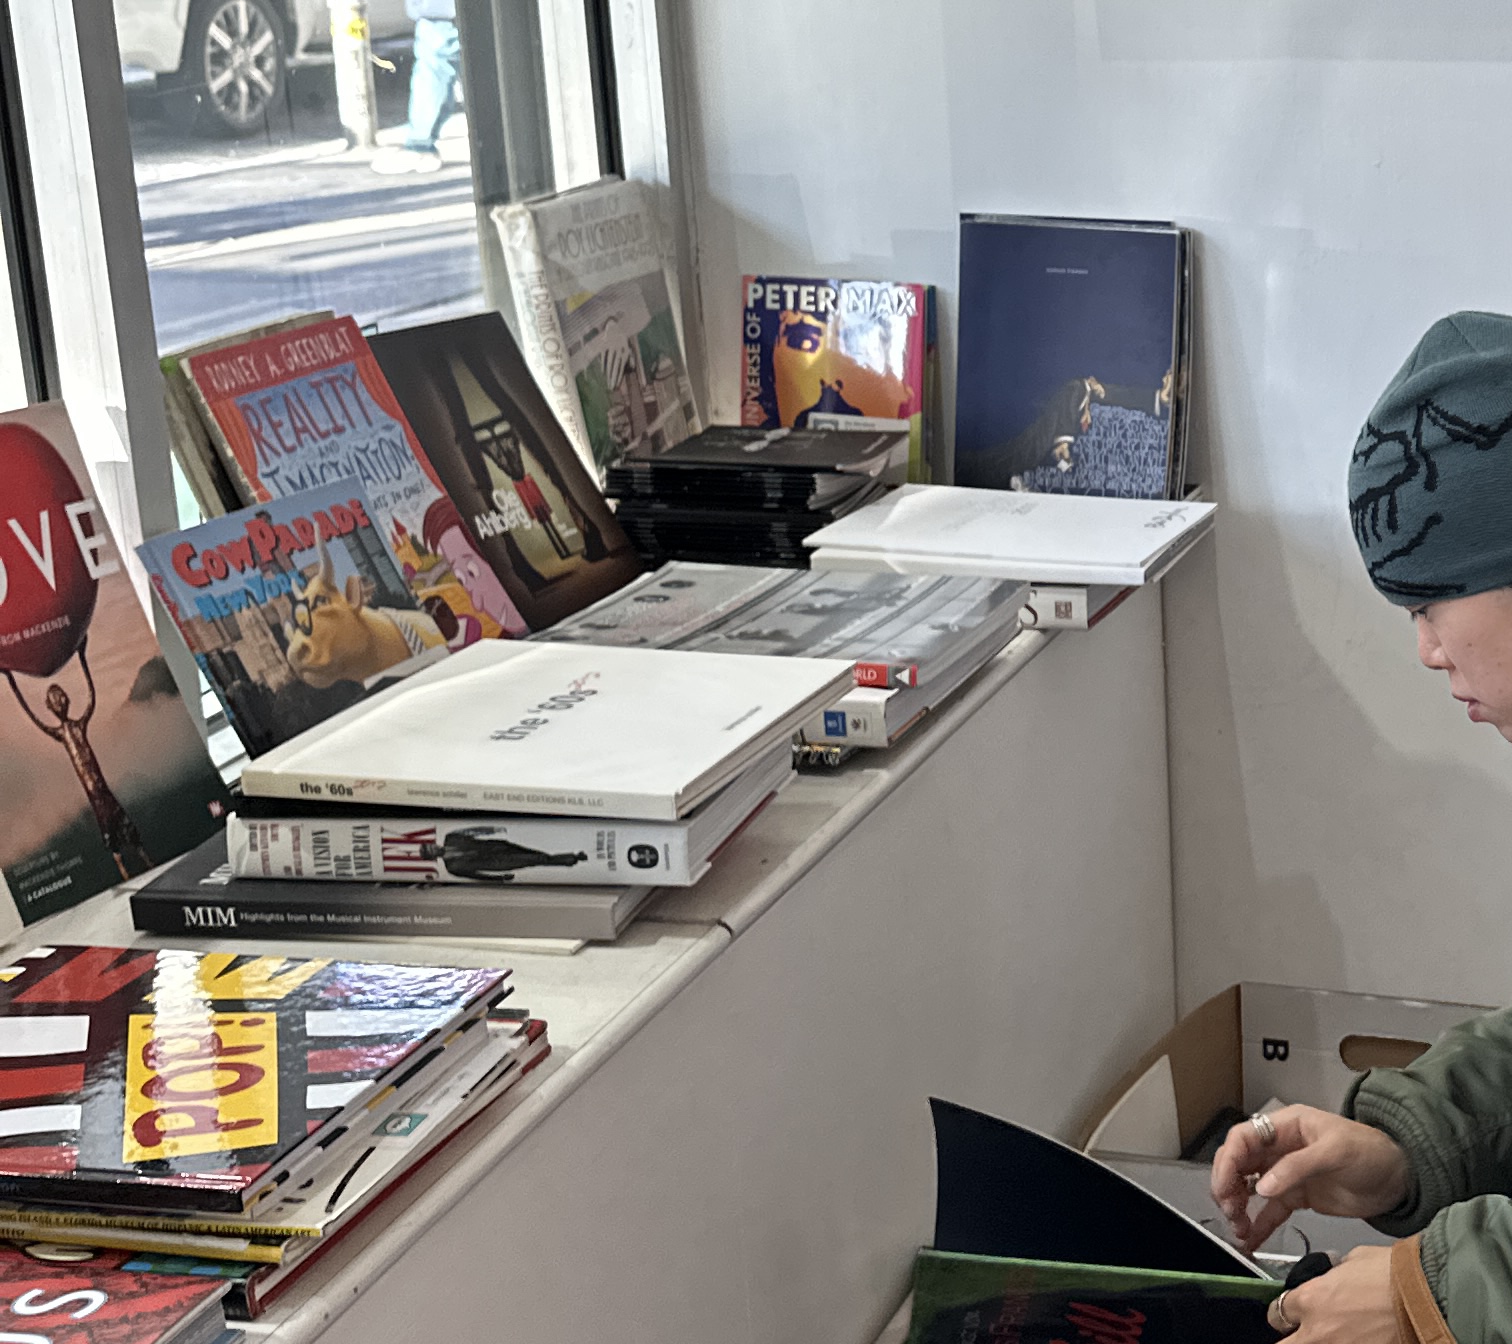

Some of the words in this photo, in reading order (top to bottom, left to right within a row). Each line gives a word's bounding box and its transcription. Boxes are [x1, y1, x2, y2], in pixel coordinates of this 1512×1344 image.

[747, 283, 836, 312] PETER
[846, 285, 916, 317] MAX
[746, 313, 762, 339] OF
[205, 356, 258, 394] RODNEY
[279, 326, 355, 373] GREENBLAT
[240, 370, 373, 467] REALITY
[317, 441, 341, 459] AND
[493, 488, 520, 511] Ole
[474, 508, 533, 540] Ahlberg
[196, 588, 249, 623] NEW
[23, 614, 72, 639] MACKENZIE
[490, 716, 550, 741] the
[300, 782, 322, 795] the
[483, 791, 505, 802] EAST
[507, 793, 525, 803] END
[526, 794, 567, 806] EDITIONS
[312, 829, 331, 867] VISION
[352, 825, 373, 877] AMERICA
[380, 825, 439, 879] JFK
[334, 855, 353, 877] FOR
[184, 905, 239, 928] MIM
[240, 911, 285, 923] Highlights
[287, 912, 308, 923] from
[310, 913, 326, 924] the
[327, 913, 361, 925] Musical
[363, 914, 412, 926] Instrument
[414, 915, 452, 926] Museum
[1262, 1037, 1290, 1061] B
